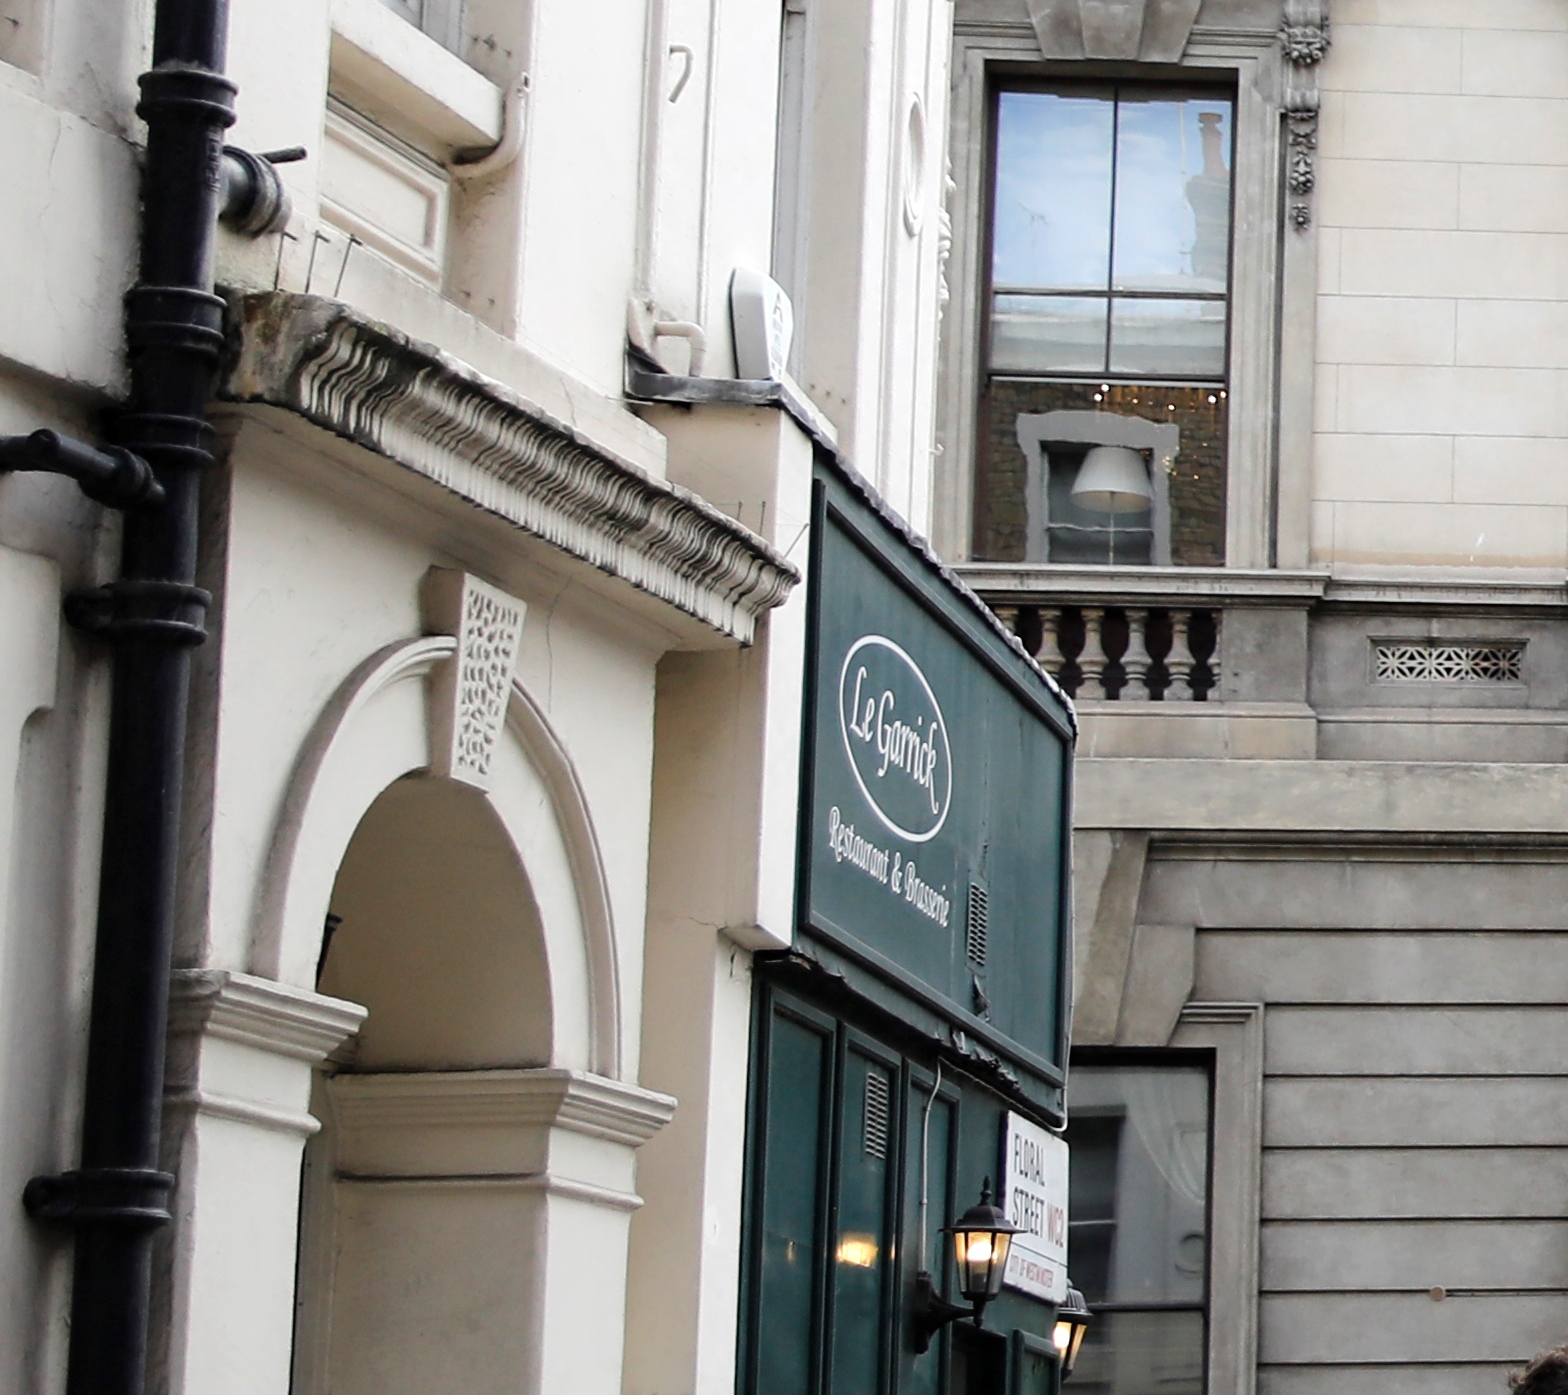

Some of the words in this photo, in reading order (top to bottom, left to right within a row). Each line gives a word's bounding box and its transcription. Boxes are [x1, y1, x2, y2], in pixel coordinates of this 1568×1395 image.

[850, 665, 876, 742] Le
[877, 690, 939, 815] Garrick
[828, 806, 890, 885] Restaurant
[891, 851, 903, 895] &
[904, 861, 950, 928] Brasserie
[1013, 1132, 1045, 1187] FLORAL
[1012, 1186, 1045, 1239] STREET
[1048, 1202, 1064, 1248] WC2
